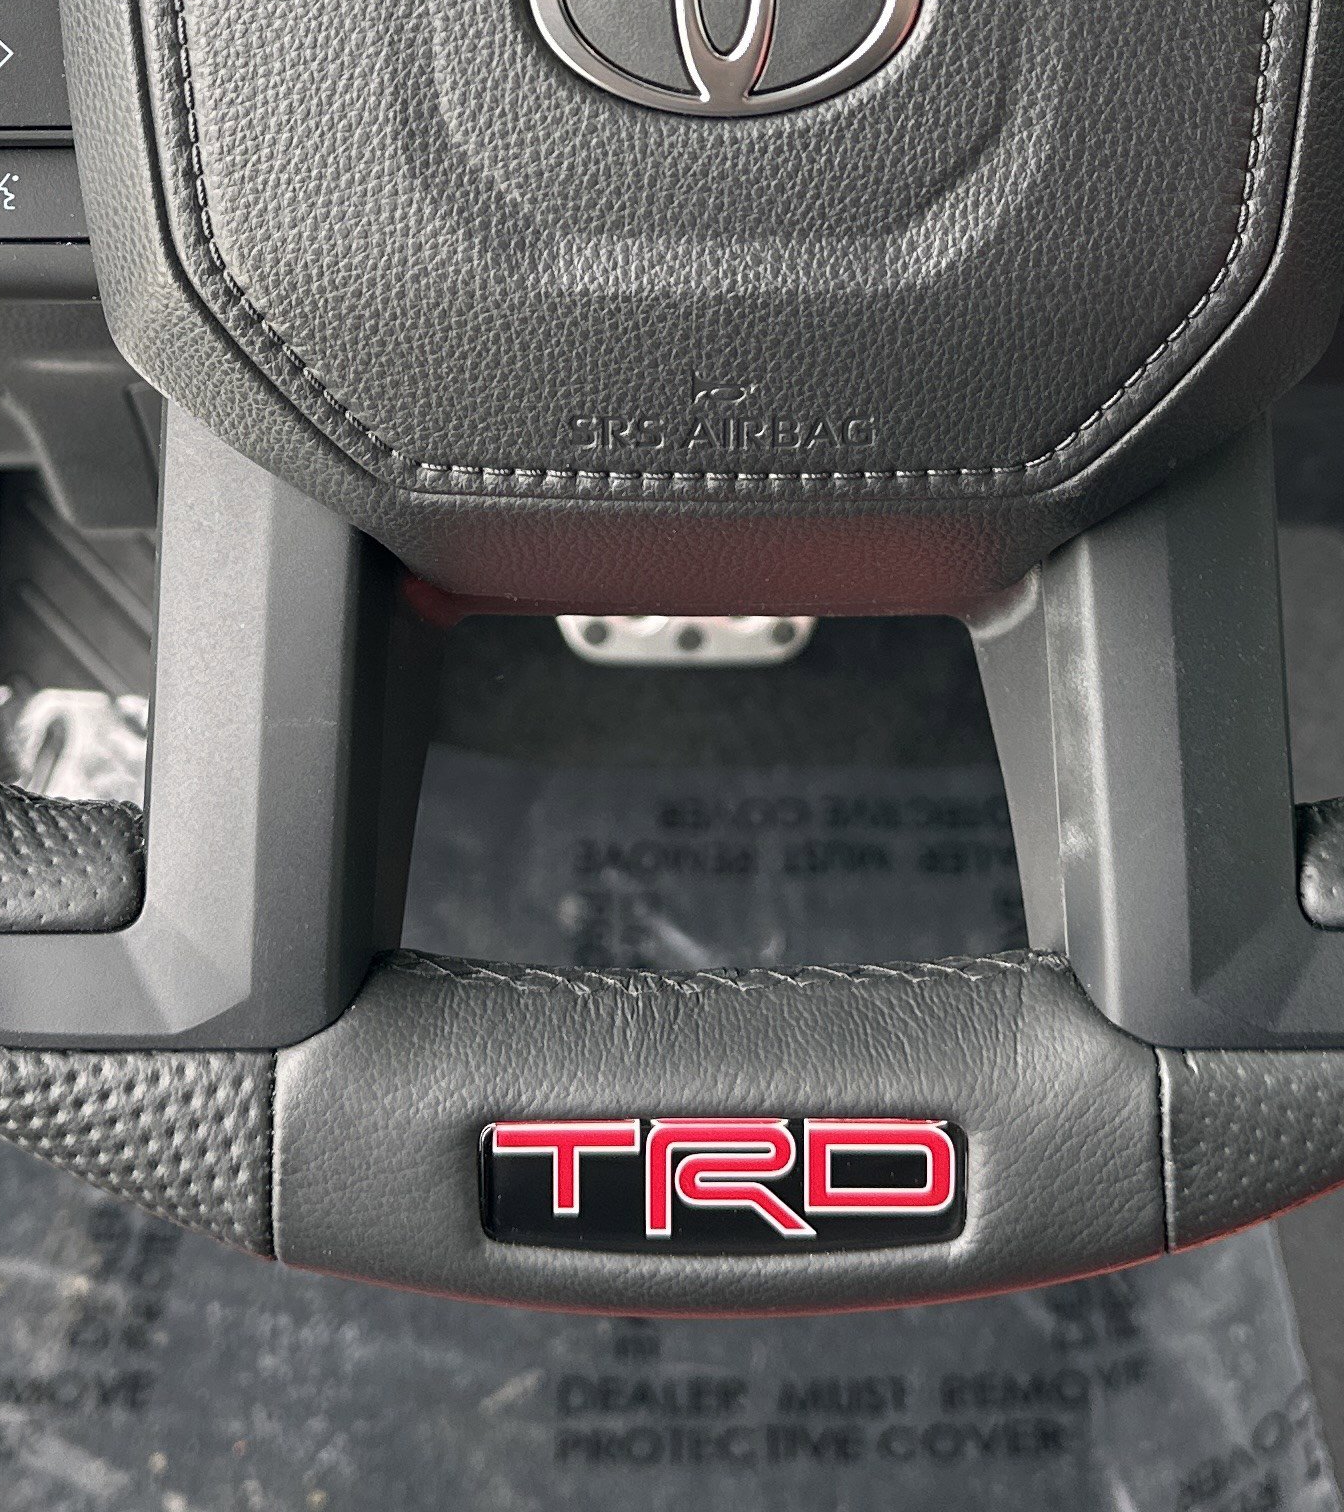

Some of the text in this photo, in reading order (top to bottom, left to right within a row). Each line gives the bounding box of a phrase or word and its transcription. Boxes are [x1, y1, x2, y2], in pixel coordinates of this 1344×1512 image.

[569, 416, 879, 450] SRS AIRBAG
[492, 1118, 956, 1239] TRD
[554, 1372, 747, 1416] DEALER
[776, 1372, 913, 1414] MUST
[875, 1417, 1070, 1463] COVER
